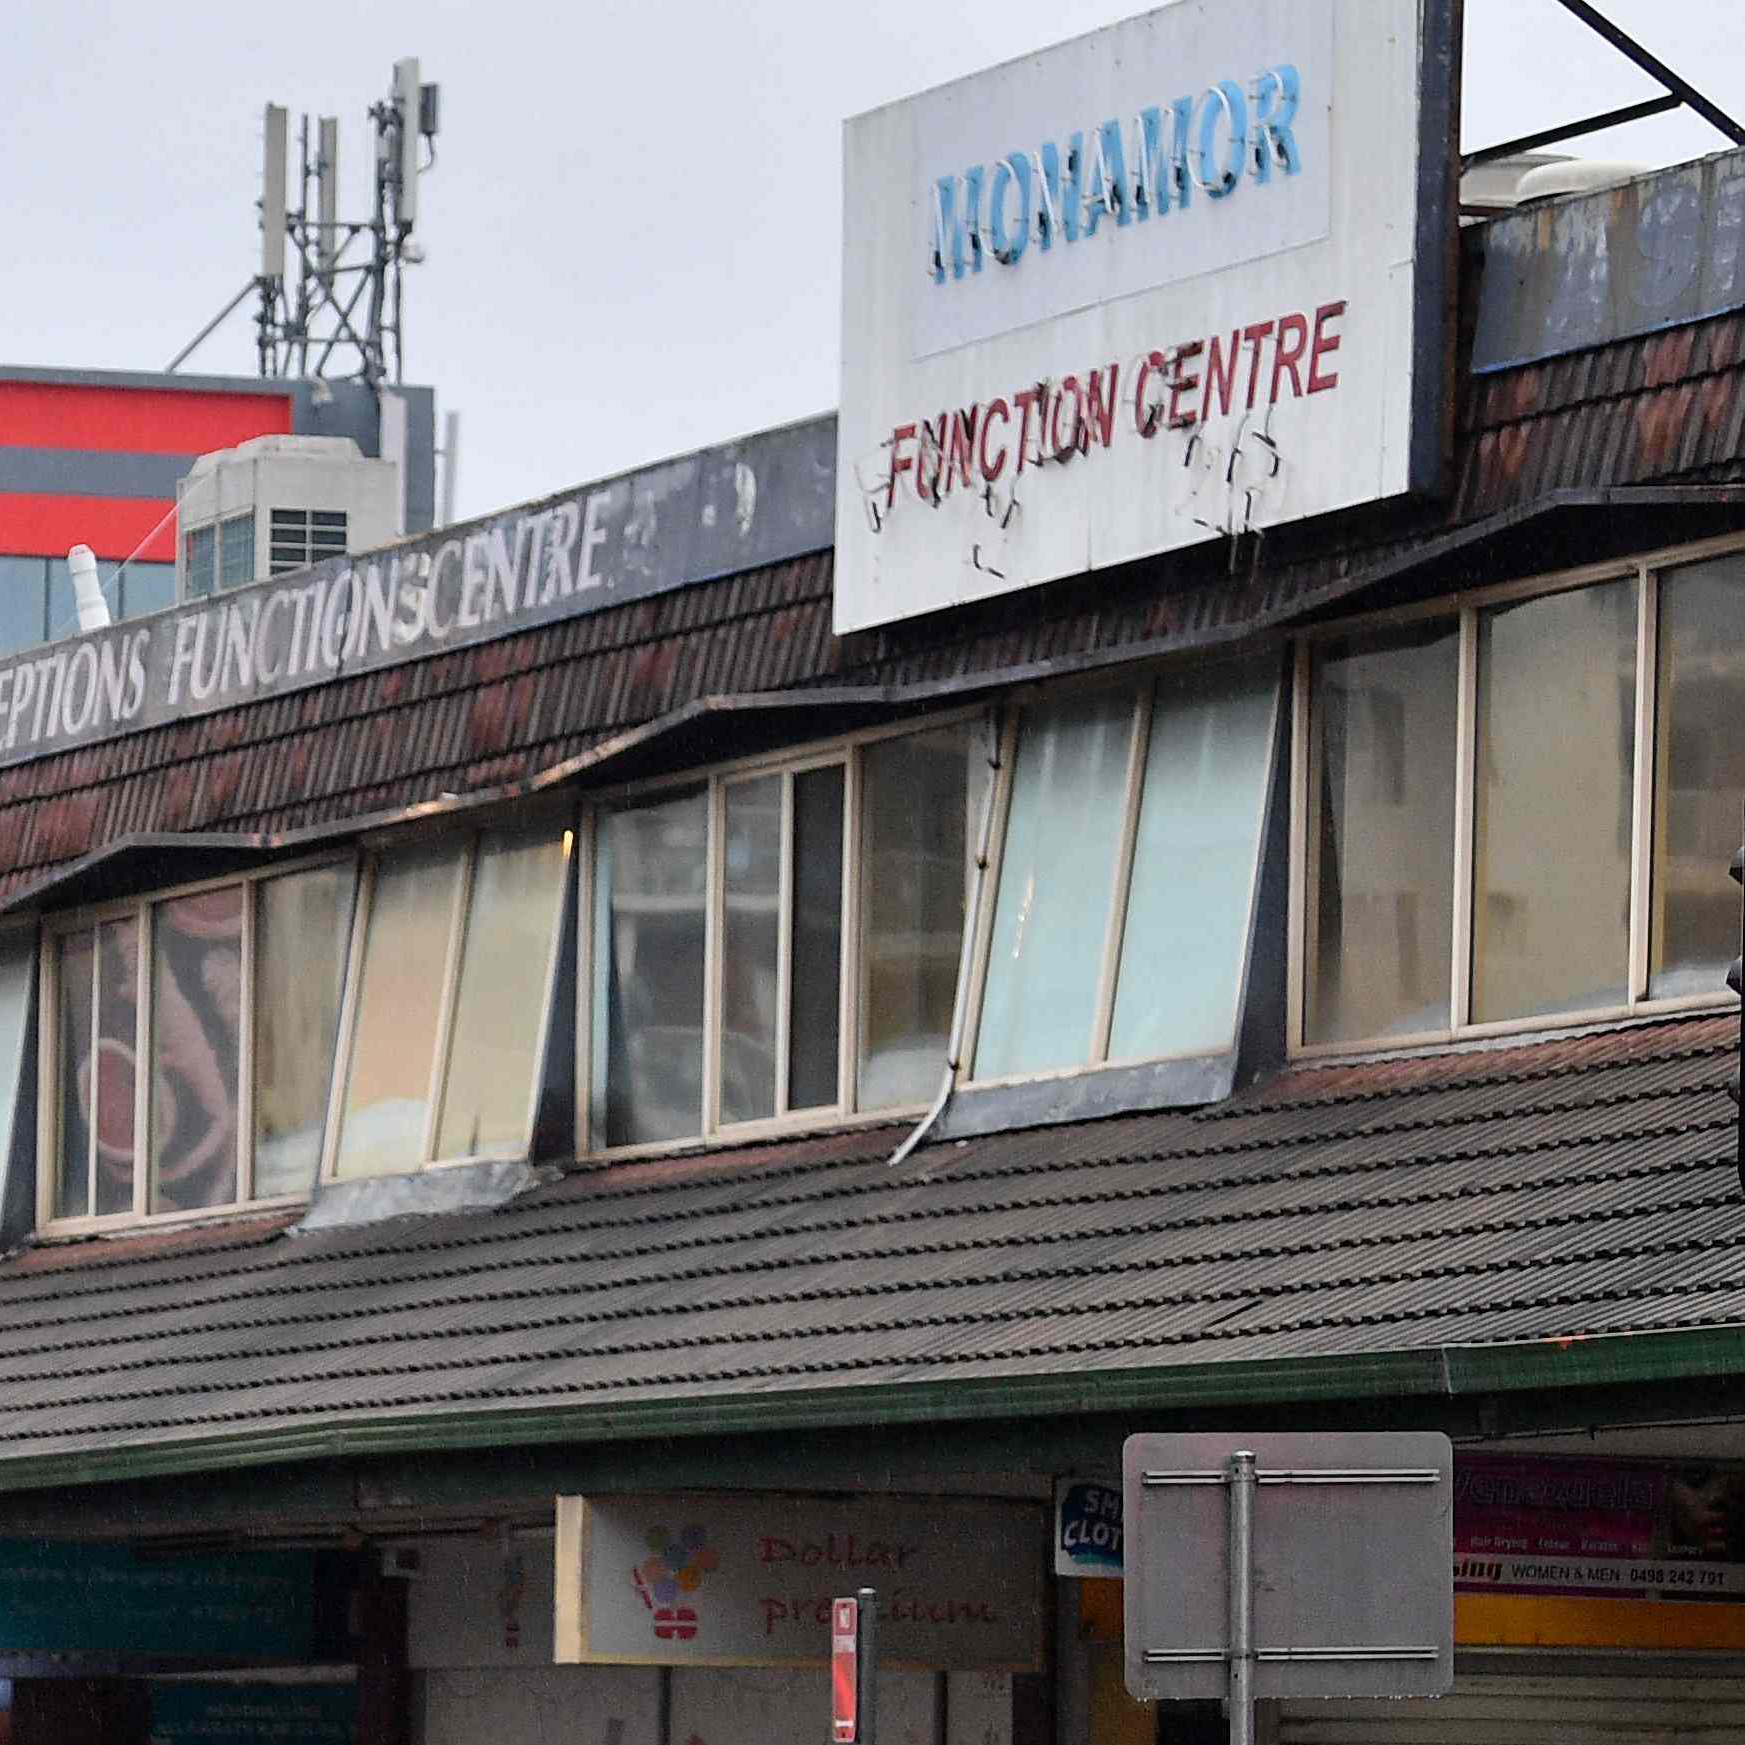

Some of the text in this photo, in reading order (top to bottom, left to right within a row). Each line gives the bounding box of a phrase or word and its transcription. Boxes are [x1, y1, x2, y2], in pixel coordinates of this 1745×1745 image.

[885, 299, 1348, 508] FUNCTION CENTRE
[758, 1534, 917, 1569] Dollar
[1511, 1563, 1570, 1581] WOMEN
[1586, 1566, 1621, 1582] MEN
